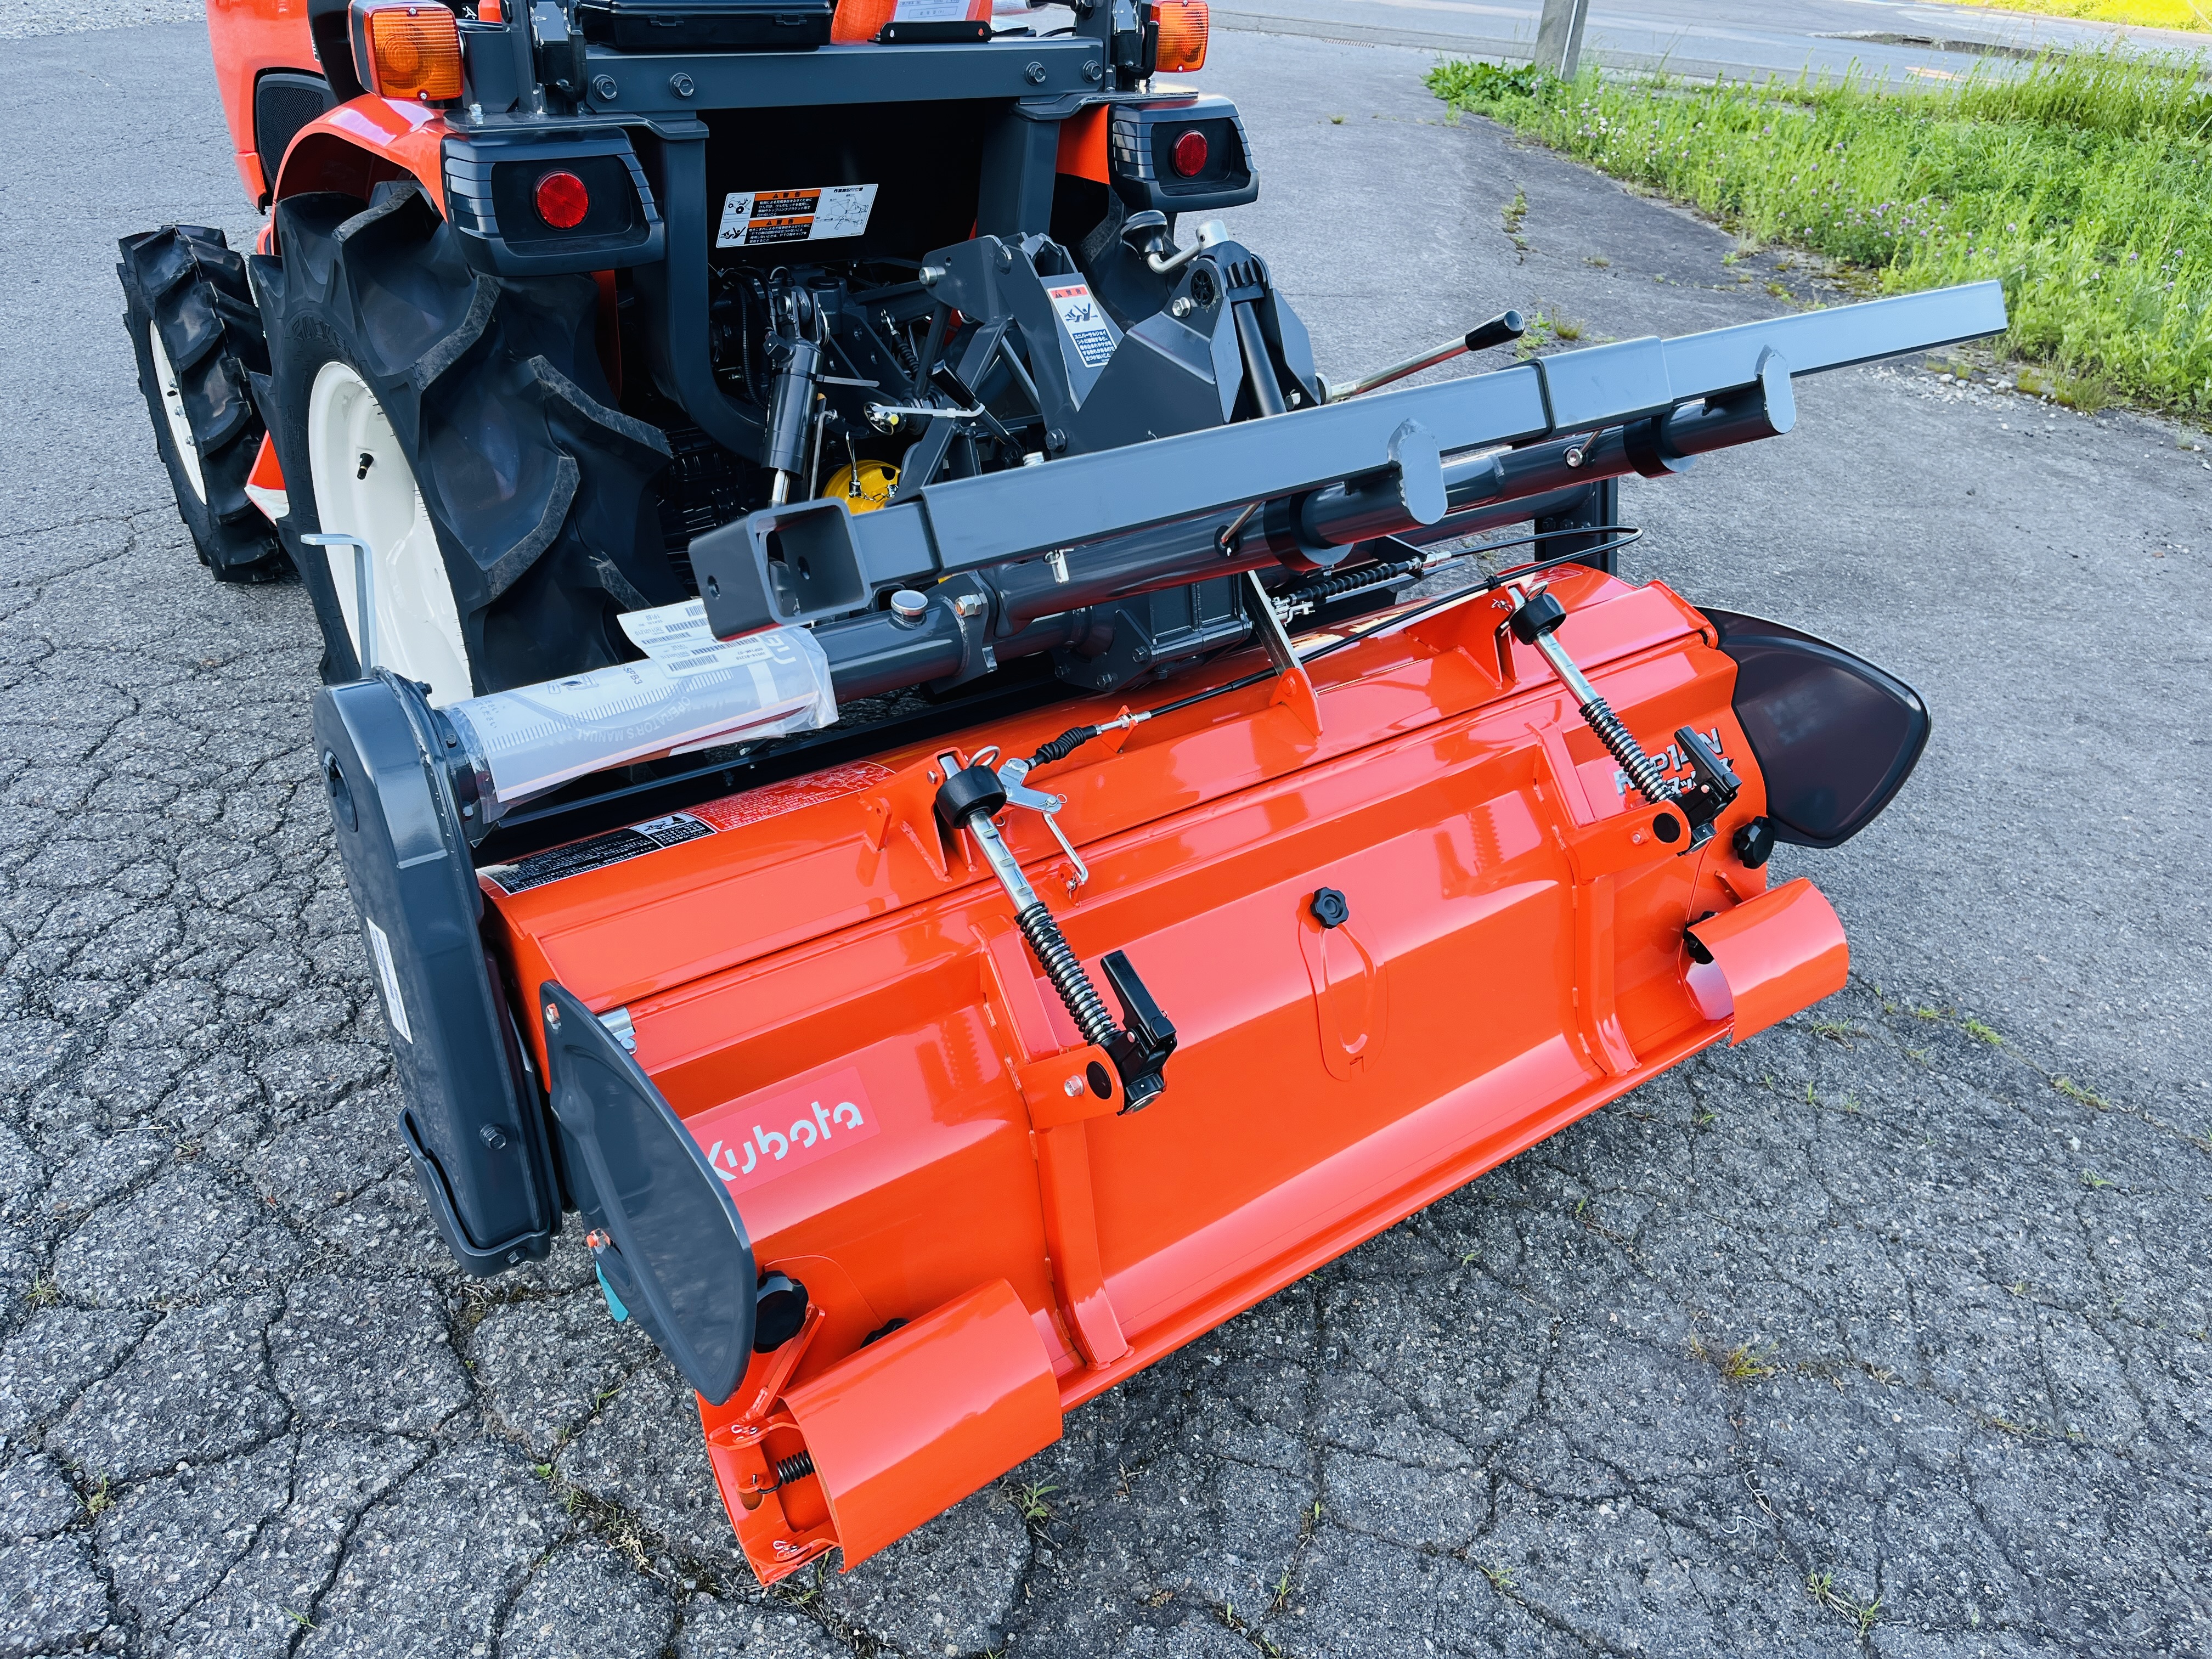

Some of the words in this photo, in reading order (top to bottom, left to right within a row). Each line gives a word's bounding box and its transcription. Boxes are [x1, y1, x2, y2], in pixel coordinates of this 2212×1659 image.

[623, 665, 642, 685] SPB3
[575, 728, 624, 742] MANUAL
[627, 696, 692, 740] OPERATOR'S
[1613, 727, 1724, 795] RP1N
[707, 1101, 864, 1182] Kubota
